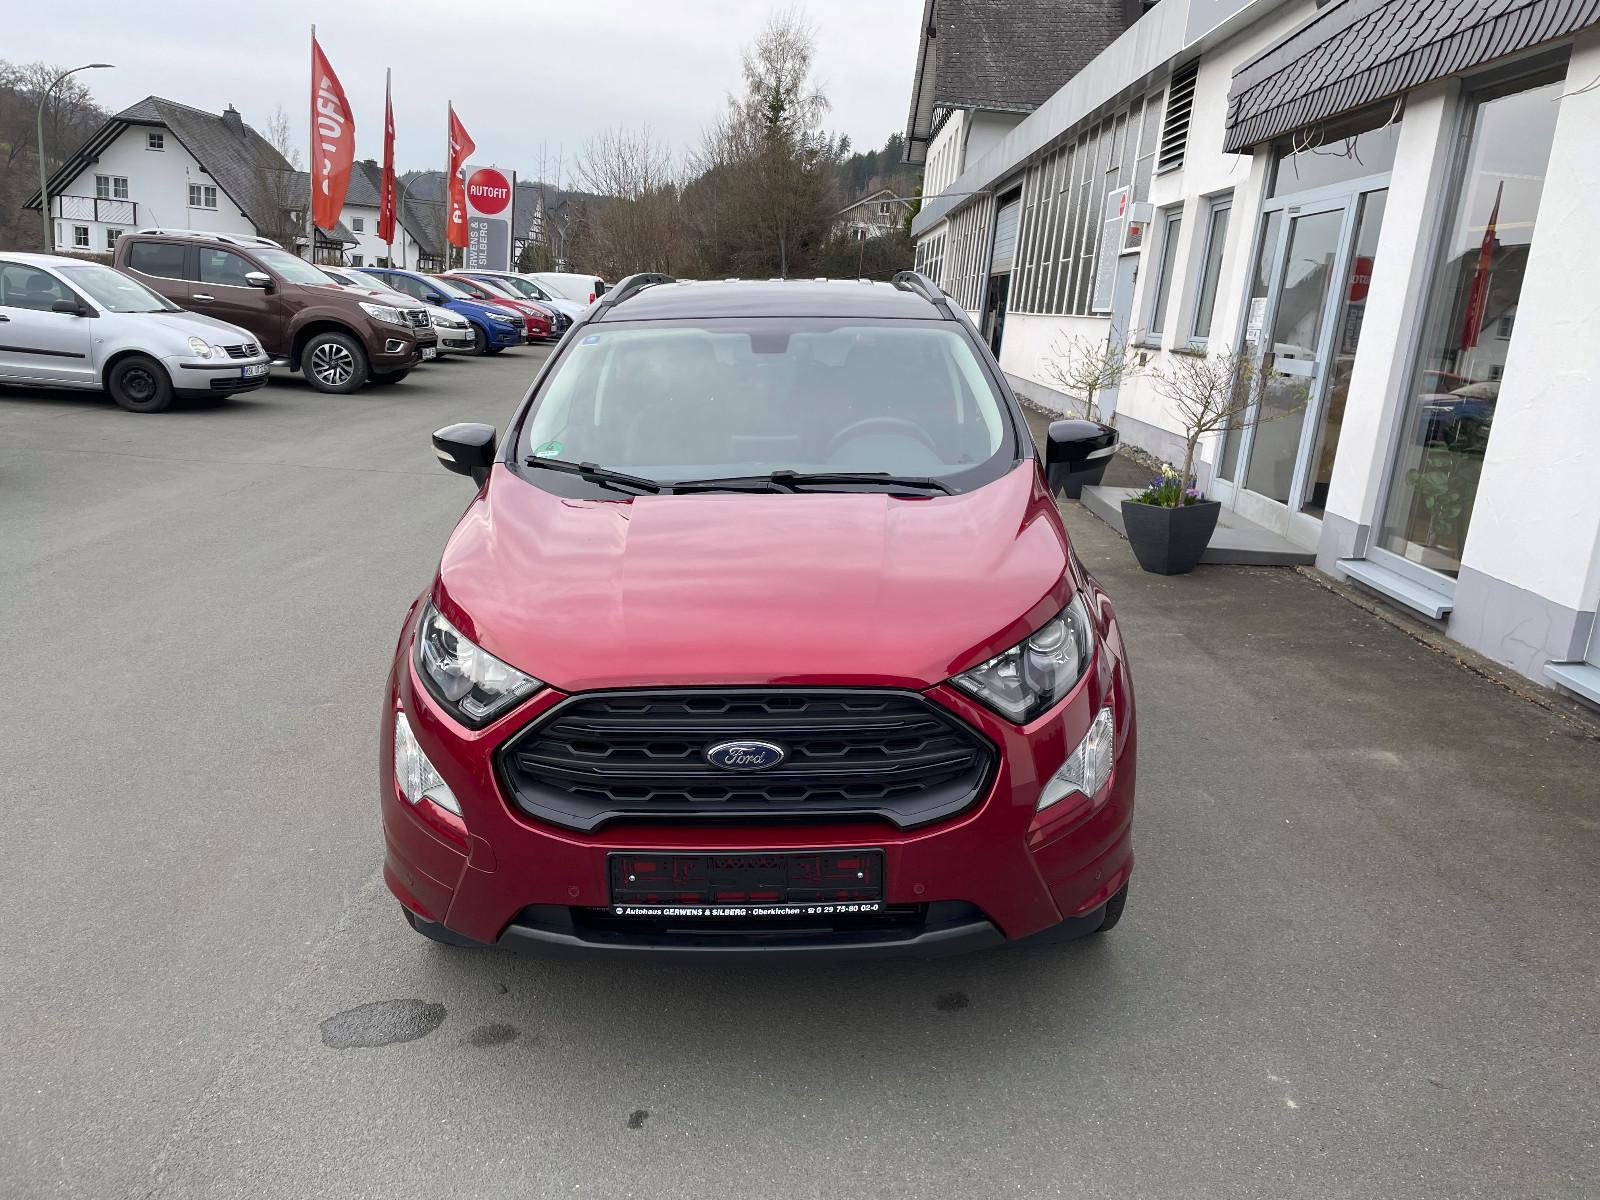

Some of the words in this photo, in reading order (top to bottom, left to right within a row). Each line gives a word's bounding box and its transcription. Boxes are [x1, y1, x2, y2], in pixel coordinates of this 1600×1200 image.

[470, 185, 507, 199] AUTOFIT
[470, 221, 478, 229] &
[469, 231, 478, 271] ERWENS
[479, 222, 488, 265] SILBERG
[724, 747, 766, 765] Ford
[625, 907, 661, 915] Autohaus
[663, 908, 703, 916] GERWENS
[704, 908, 711, 916] &
[711, 907, 747, 916] SILBERG
[752, 907, 800, 915] Oberkirchen
